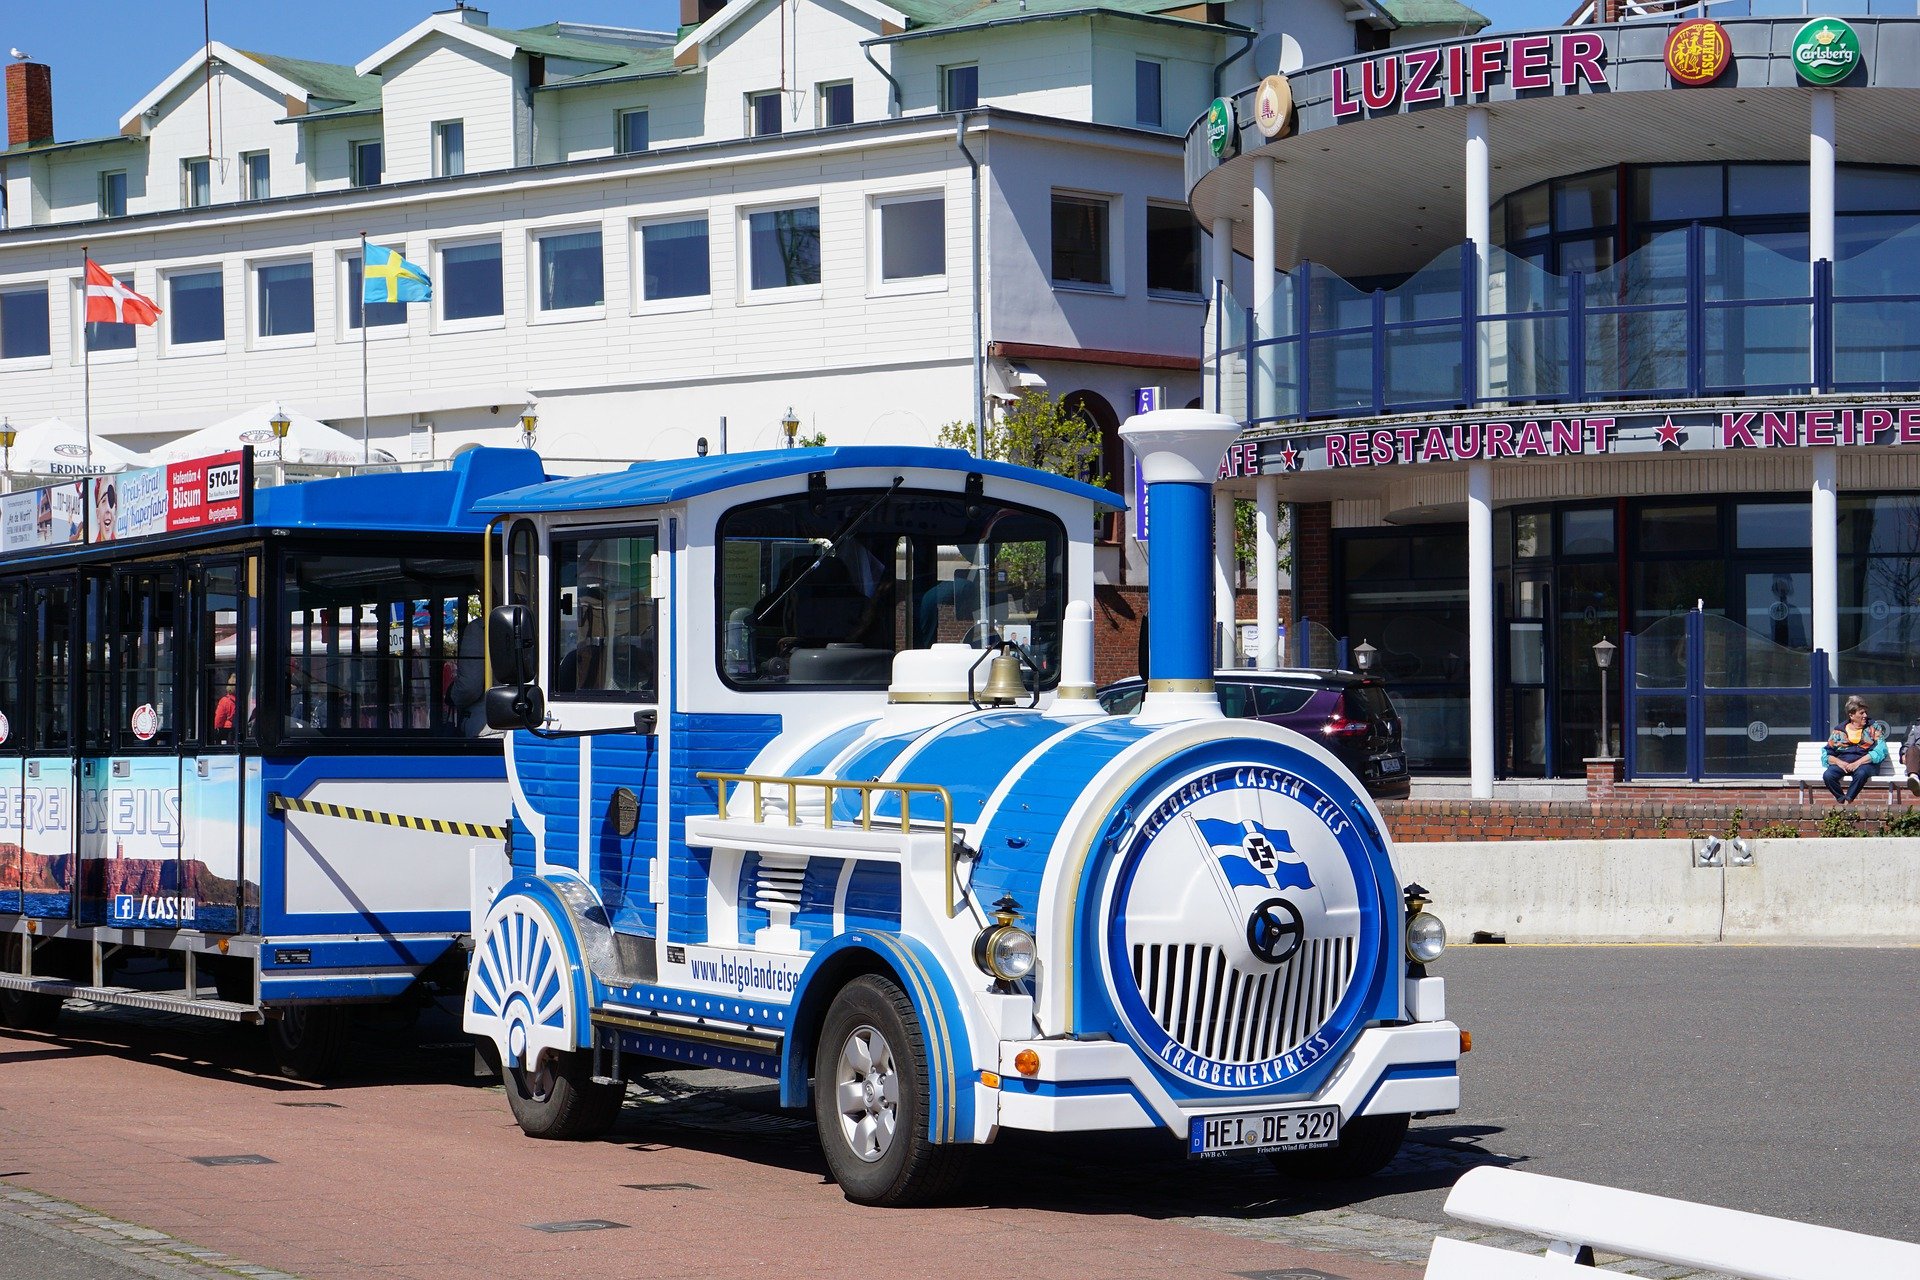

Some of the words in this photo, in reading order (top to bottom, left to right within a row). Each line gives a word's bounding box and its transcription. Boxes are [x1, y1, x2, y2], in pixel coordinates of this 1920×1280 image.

[1796, 43, 1854, 64] Carlsberg
[1332, 33, 1607, 117] LUZIFER
[1218, 443, 1257, 477] AFE
[1325, 417, 1616, 467] RESTAURANT
[1722, 409, 1920, 447] KNEIPE
[50, 462, 106, 474] ERDINGER
[209, 470, 238, 488] STOLZ
[173, 487, 201, 509] Büsum
[112, 788, 185, 848] EILS
[1143, 774, 1218, 840] REEDEREI
[1235, 768, 1304, 799] CASSEN
[1312, 796, 1349, 835] EILS
[1255, 846, 1268, 862] E
[691, 955, 802, 993] www.helgolandreise
[1160, 1031, 1329, 1086] KRABBENEXPRESS
[1205, 1118, 1244, 1148] HEI
[1262, 1115, 1288, 1143] DE
[1296, 1112, 1335, 1140] 329
[1200, 1151, 1216, 1159] FWB
